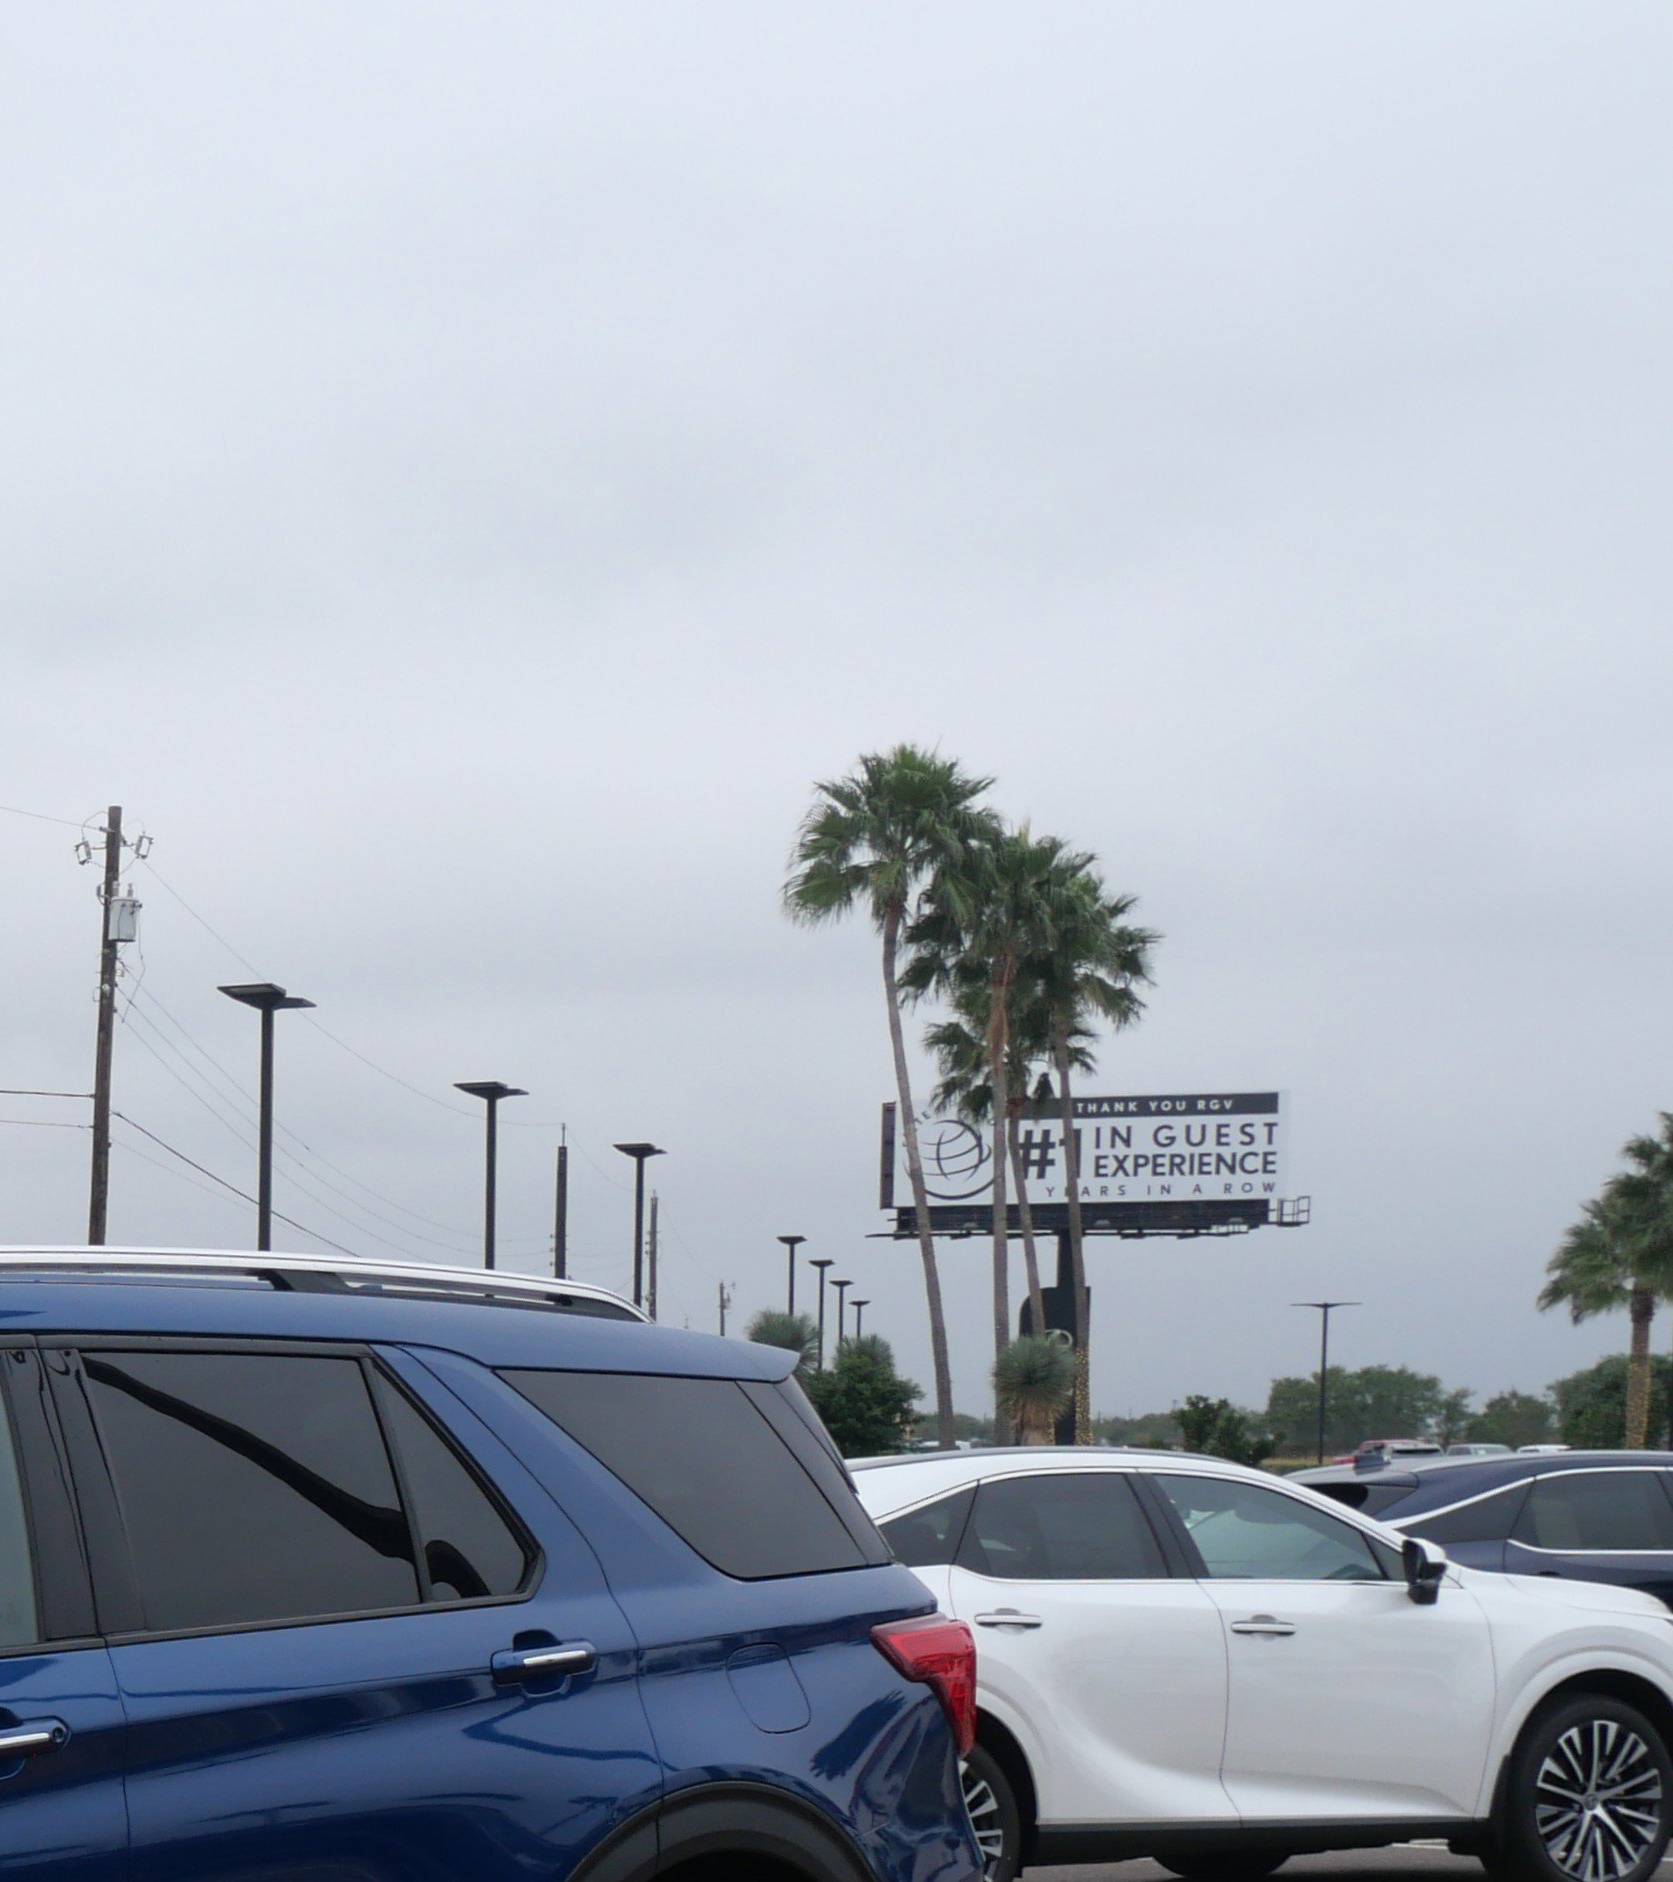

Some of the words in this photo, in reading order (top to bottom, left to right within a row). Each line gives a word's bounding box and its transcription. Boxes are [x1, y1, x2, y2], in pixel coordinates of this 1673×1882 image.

[1076, 1101, 1138, 1113] THANK
[1149, 1100, 1186, 1112] YOU
[1196, 1099, 1233, 1110] RGV
[1094, 1125, 1132, 1149] IN
[1152, 1122, 1278, 1148] GUEST
[1094, 1151, 1277, 1178] EXPERIENCE
[1147, 1184, 1172, 1195] IN
[1192, 1183, 1202, 1194] A
[1223, 1182, 1275, 1194] ROW
